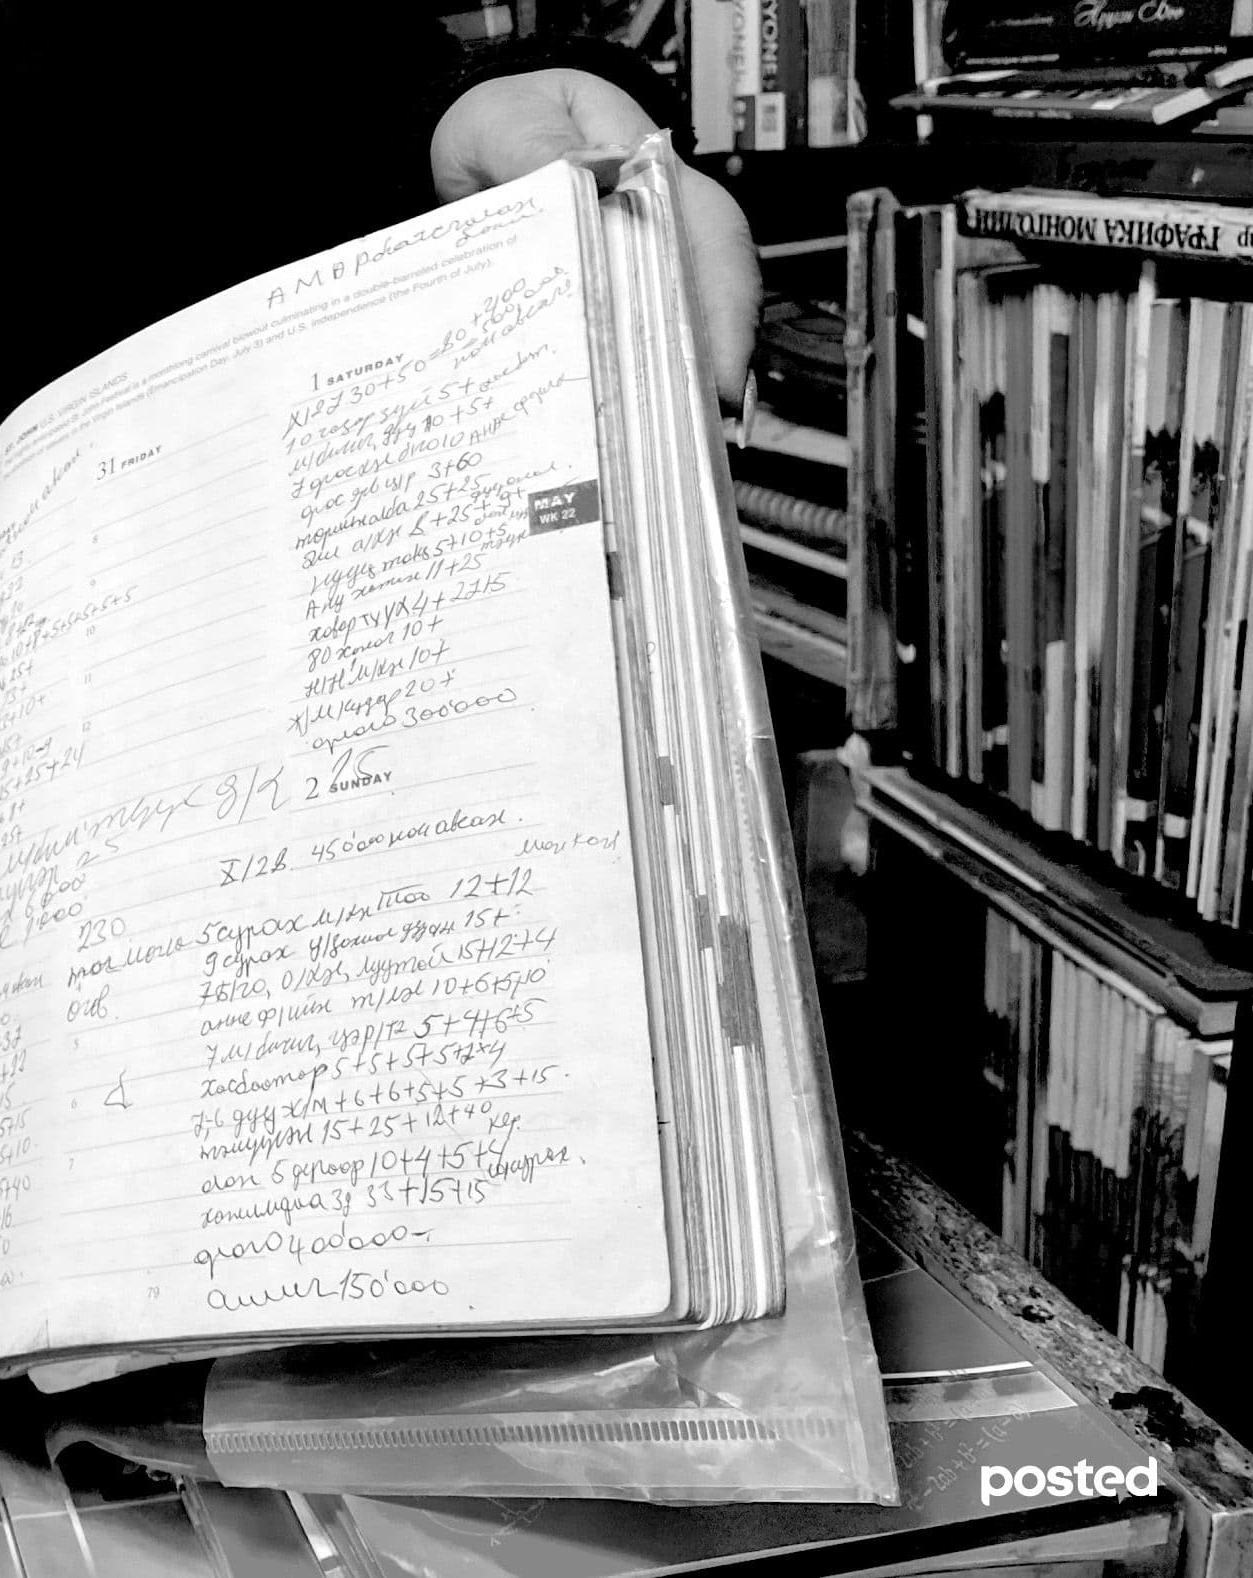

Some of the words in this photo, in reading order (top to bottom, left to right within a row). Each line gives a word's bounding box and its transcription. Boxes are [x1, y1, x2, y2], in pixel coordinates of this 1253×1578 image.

[1104, 218, 1220, 252] ГРАФИКА
[270, 301, 329, 328] culminating
[331, 296, 341, 307] in
[353, 261, 438, 300] double-barreled
[441, 239, 505, 268] celebration
[265, 329, 285, 345] and
[311, 294, 387, 328] Independence
[389, 286, 410, 304] (the
[412, 270, 448, 294] Fourth
[325, 352, 405, 387] SATURDAY
[97, 456, 116, 481] 31
[120, 444, 162, 470] FRIDAY
[533, 491, 576, 511] MAY
[539, 509, 559, 525] WK
[560, 507, 577, 521] 22
[305, 777, 320, 801] 2
[328, 770, 393, 795] SUNDAY
